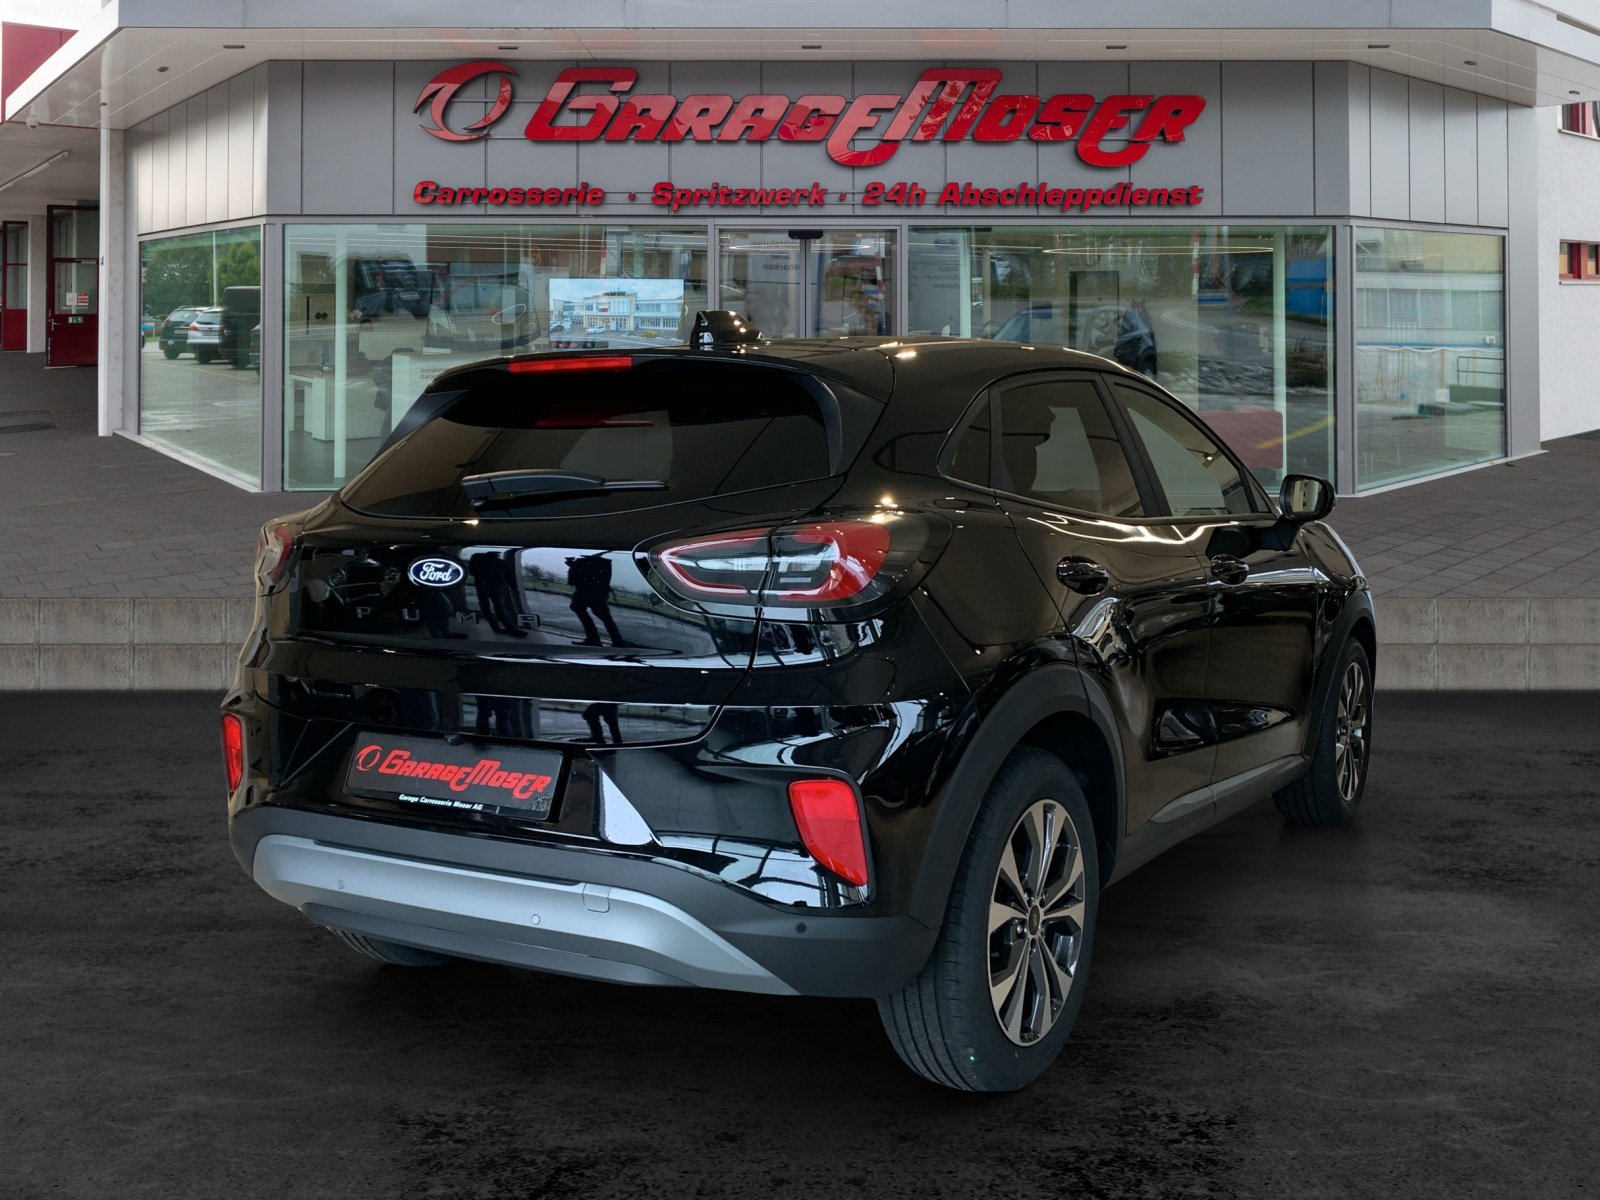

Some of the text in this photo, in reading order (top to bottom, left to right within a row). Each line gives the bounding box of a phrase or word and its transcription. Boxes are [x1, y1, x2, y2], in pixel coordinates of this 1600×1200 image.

[413, 180, 1205, 212] Carrosserie Spritzwerk 24h Abschleppdienst
[419, 561, 454, 584] Ford
[356, 606, 541, 629] PUMA
[399, 794, 484, 811] Garage Carrosserie Moser AG
